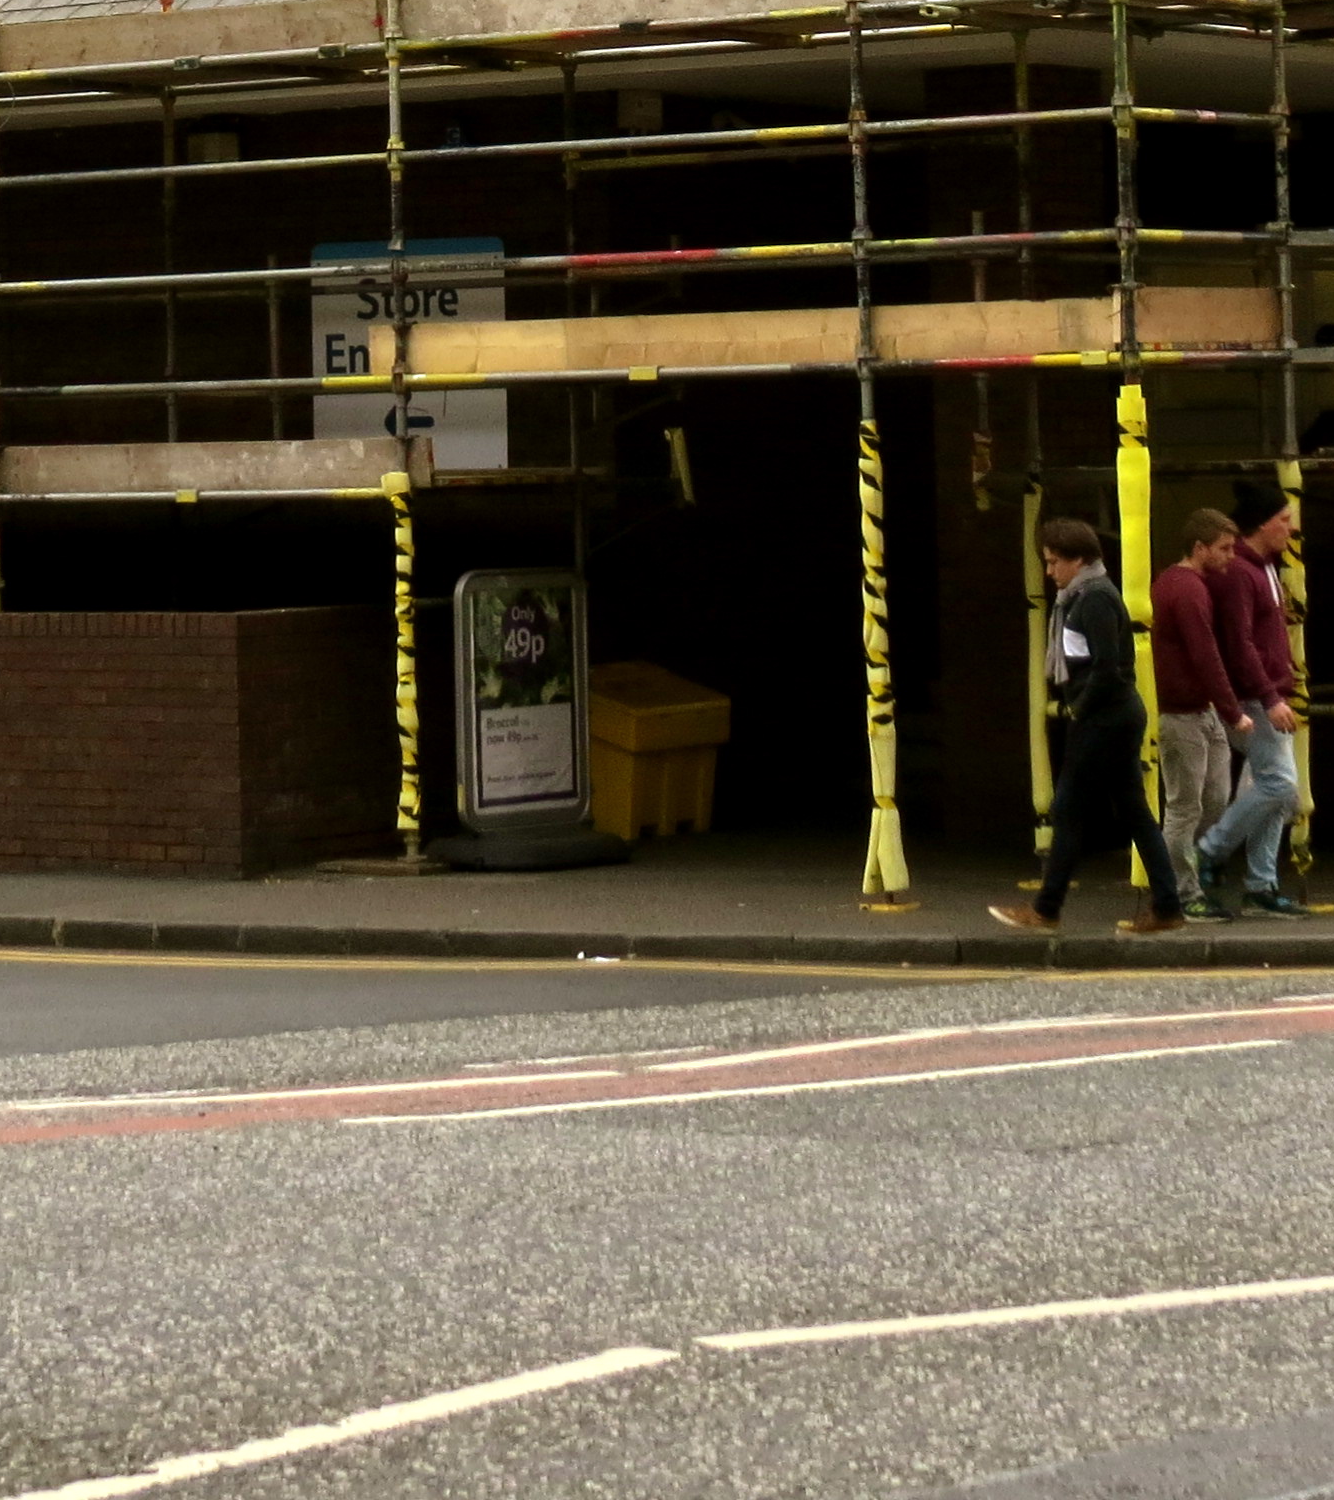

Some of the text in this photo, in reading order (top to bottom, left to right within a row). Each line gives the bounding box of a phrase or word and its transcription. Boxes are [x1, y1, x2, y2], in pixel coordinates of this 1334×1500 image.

[357, 278, 459, 320] Store
[511, 605, 536, 623] Only
[504, 627, 545, 664] 49p
